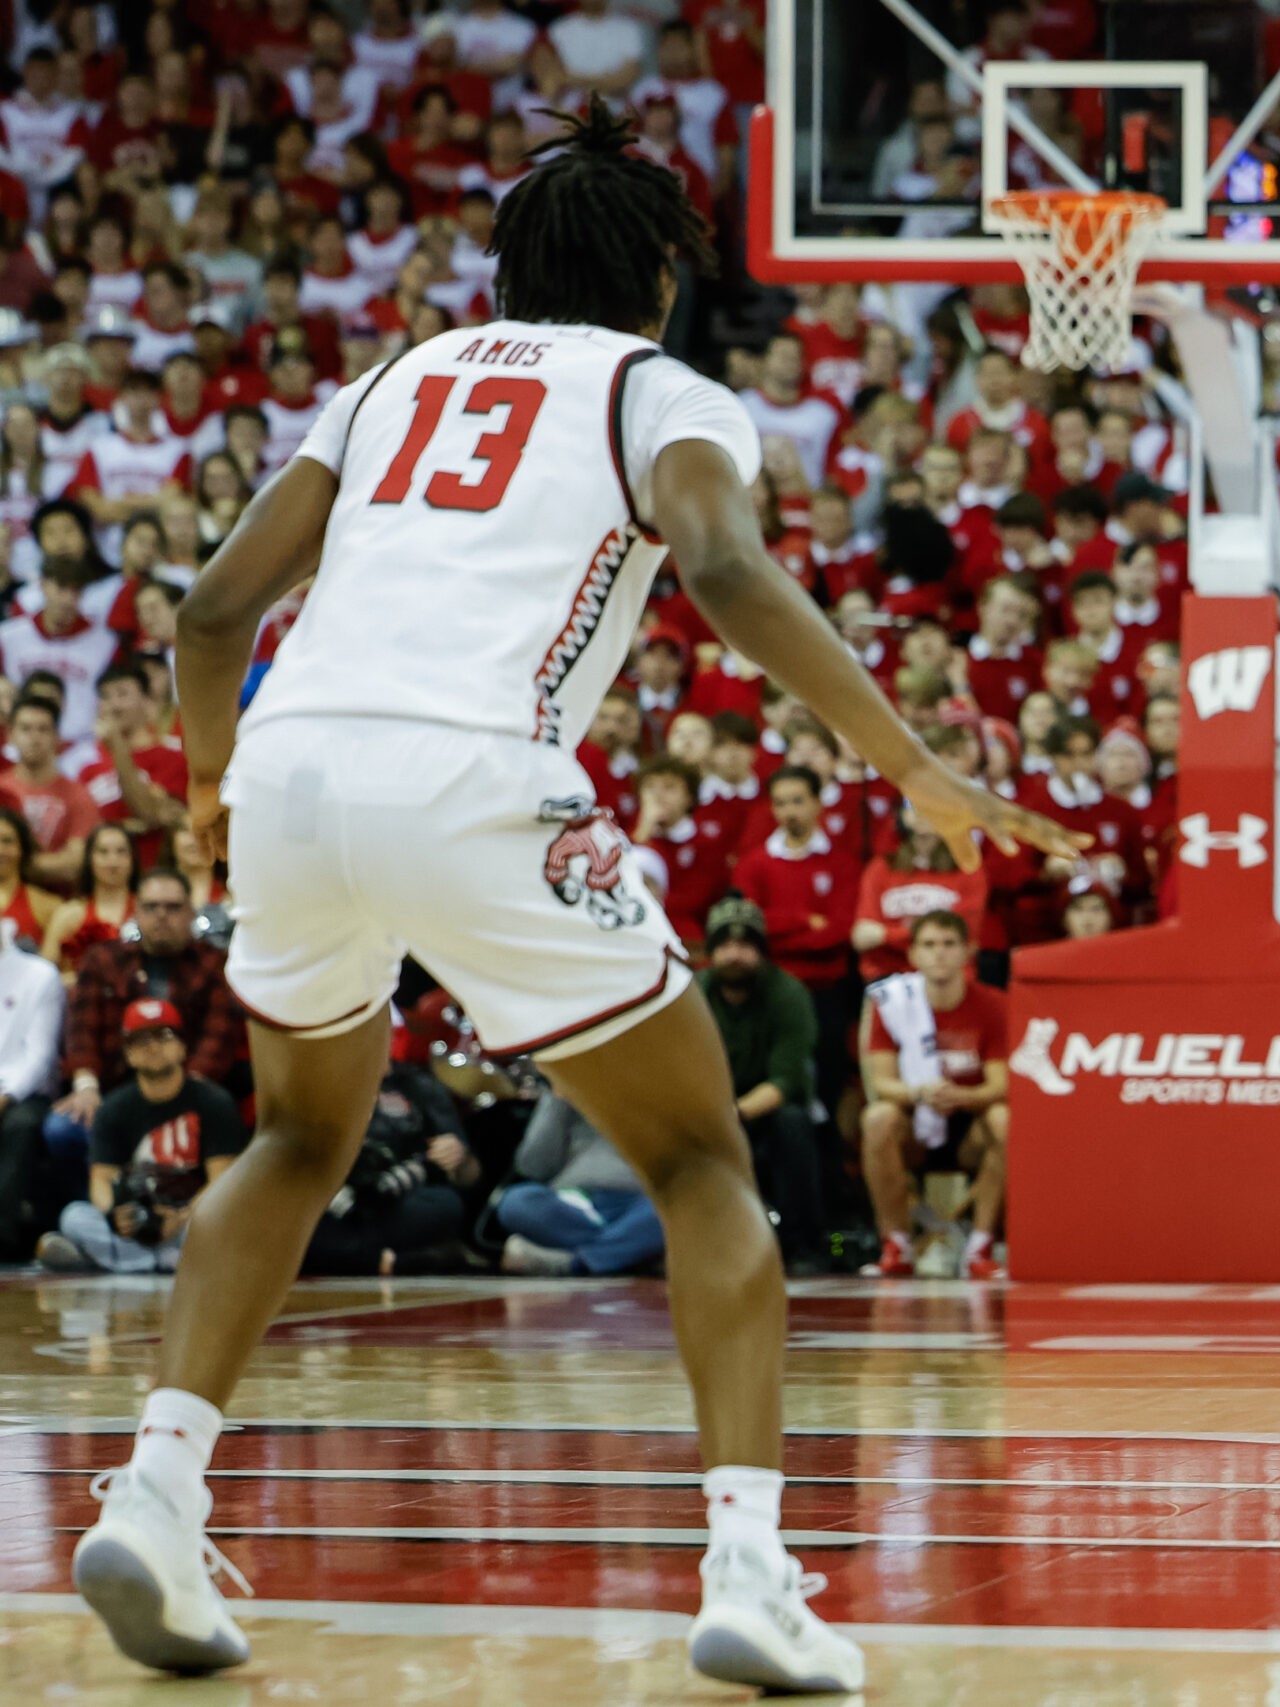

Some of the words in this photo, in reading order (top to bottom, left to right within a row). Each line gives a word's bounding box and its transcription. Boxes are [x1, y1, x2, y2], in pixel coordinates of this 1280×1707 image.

[455, 337, 552, 367] AMOS
[368, 374, 549, 513] 13
[1186, 645, 1272, 721] W
[1121, 1079, 1226, 1105] SPORTS
